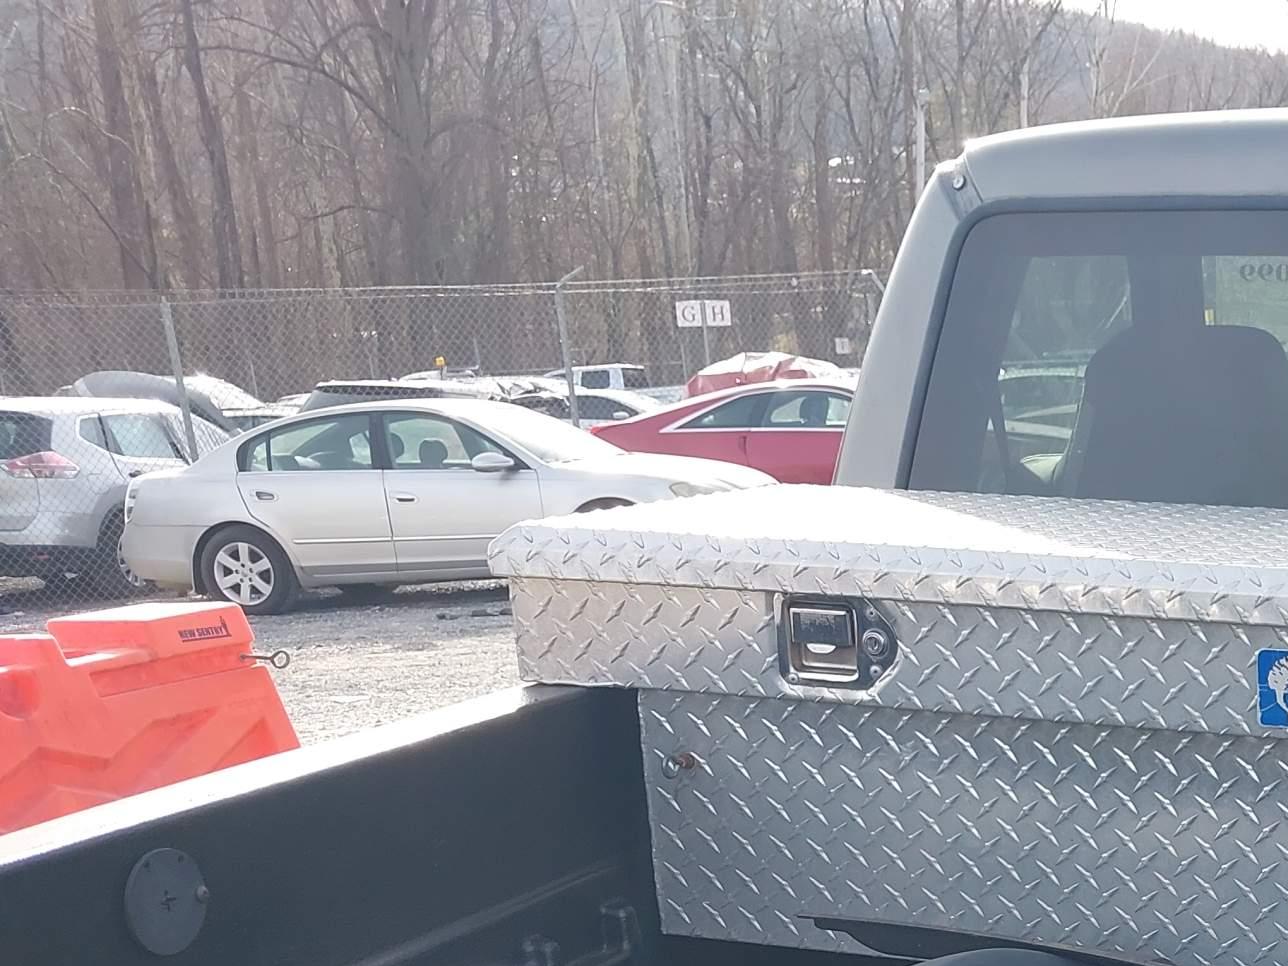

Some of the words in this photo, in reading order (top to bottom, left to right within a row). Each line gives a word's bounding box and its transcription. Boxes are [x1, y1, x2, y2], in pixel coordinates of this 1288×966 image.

[682, 306, 695, 323] G
[712, 305, 724, 322] H
[178, 629, 196, 638] NEW
[197, 626, 223, 637] SENTRY
